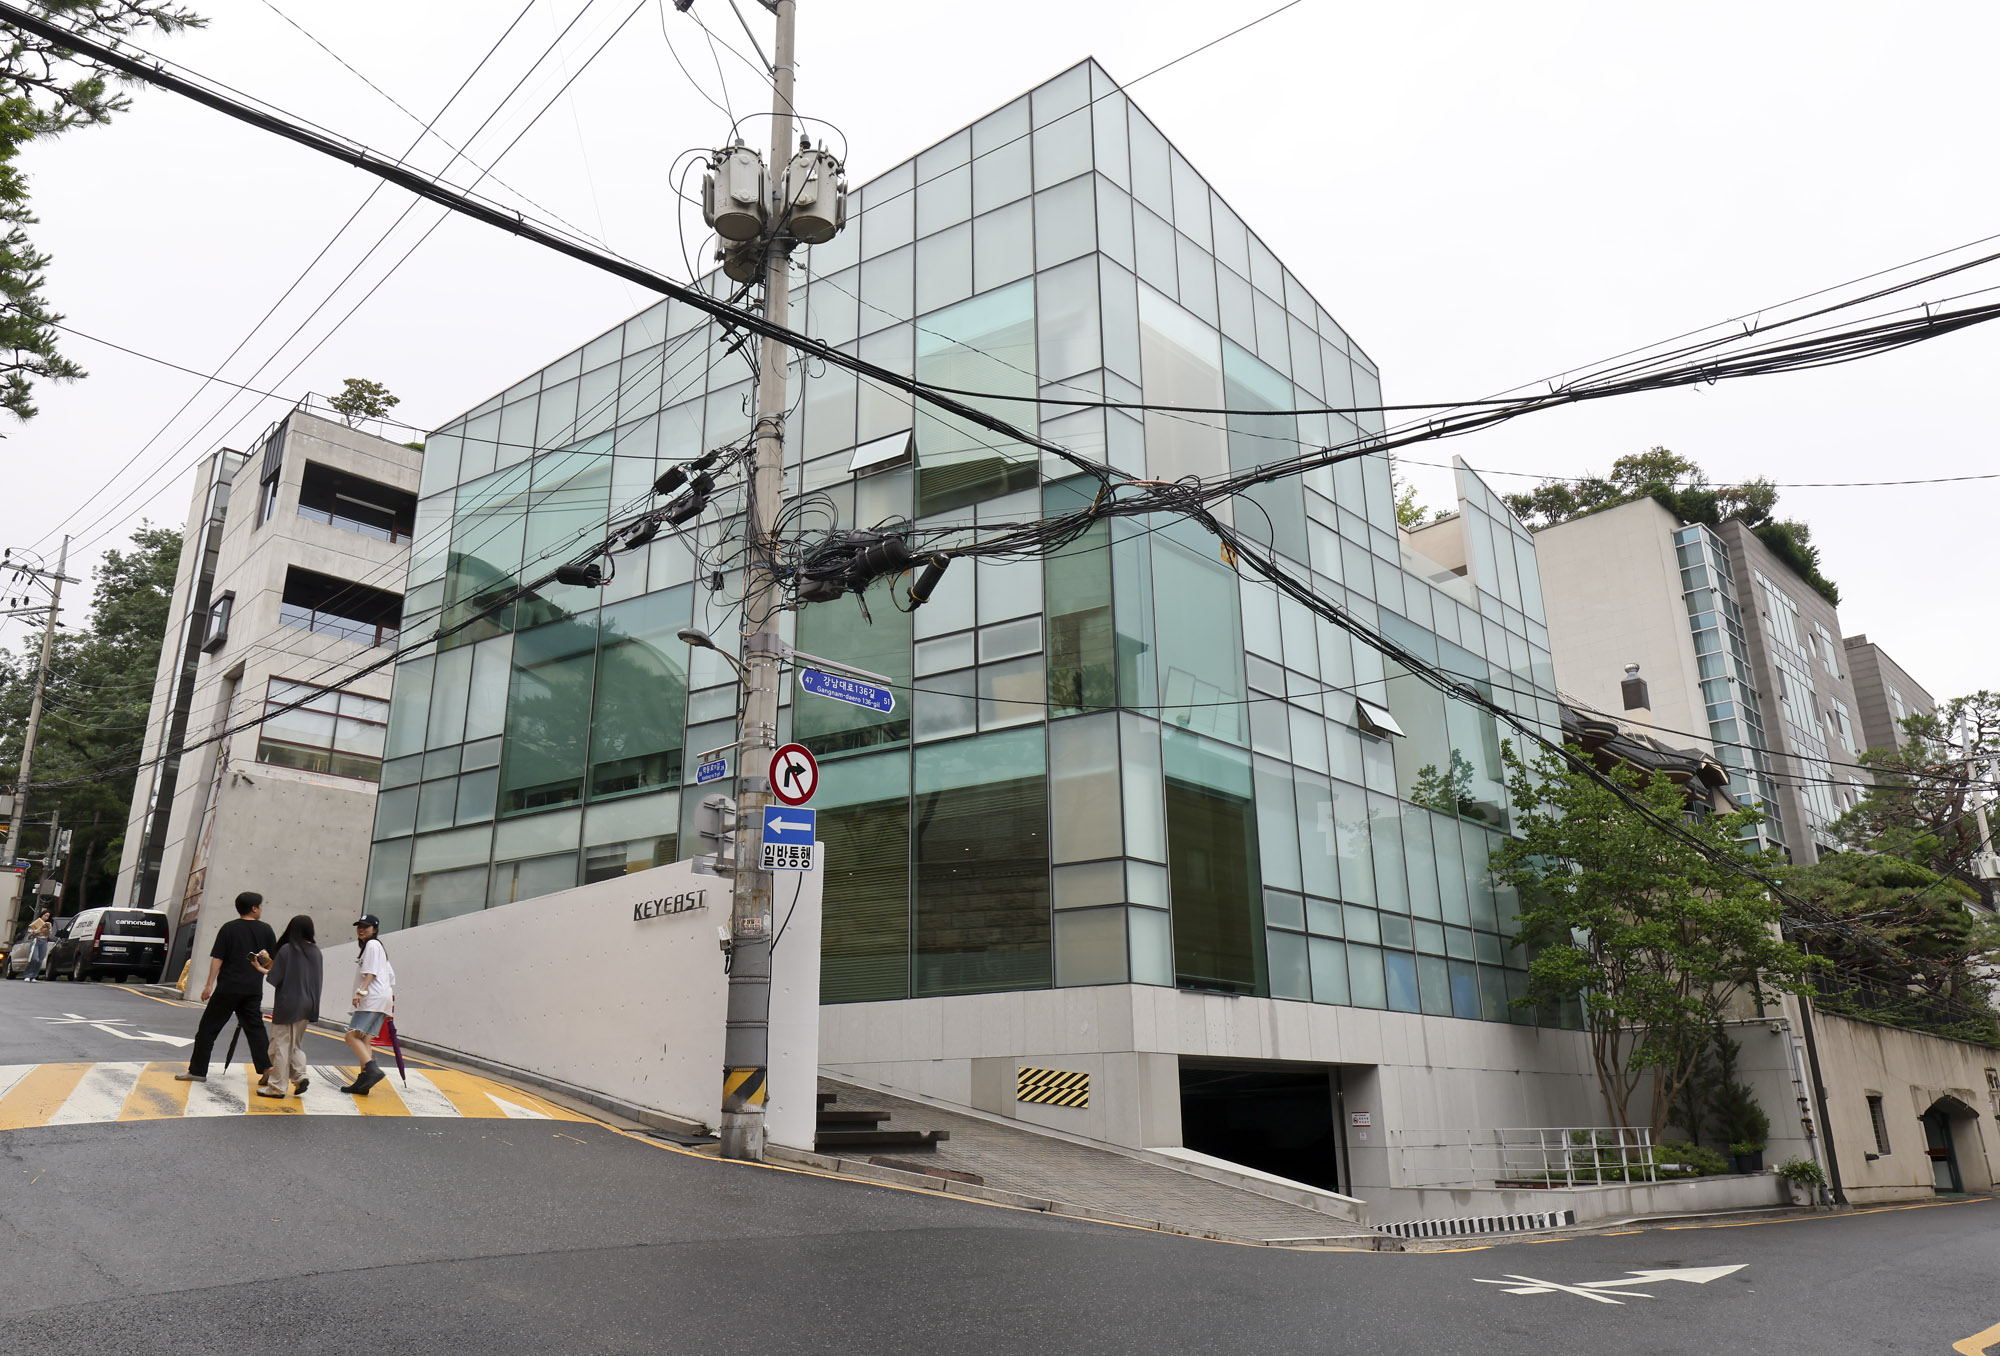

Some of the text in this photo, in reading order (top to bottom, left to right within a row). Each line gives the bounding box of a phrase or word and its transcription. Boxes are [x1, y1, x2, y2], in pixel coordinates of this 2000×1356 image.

[805, 676, 813, 684] 47
[823, 676, 876, 699] 강남대로136길
[816, 685, 881, 708] Gangnam-daero 136-gil
[883, 697, 891, 705] 51
[763, 844, 811, 869] 일방통행
[633, 889, 707, 922] KEYEAST
[115, 919, 156, 927] cannondale
